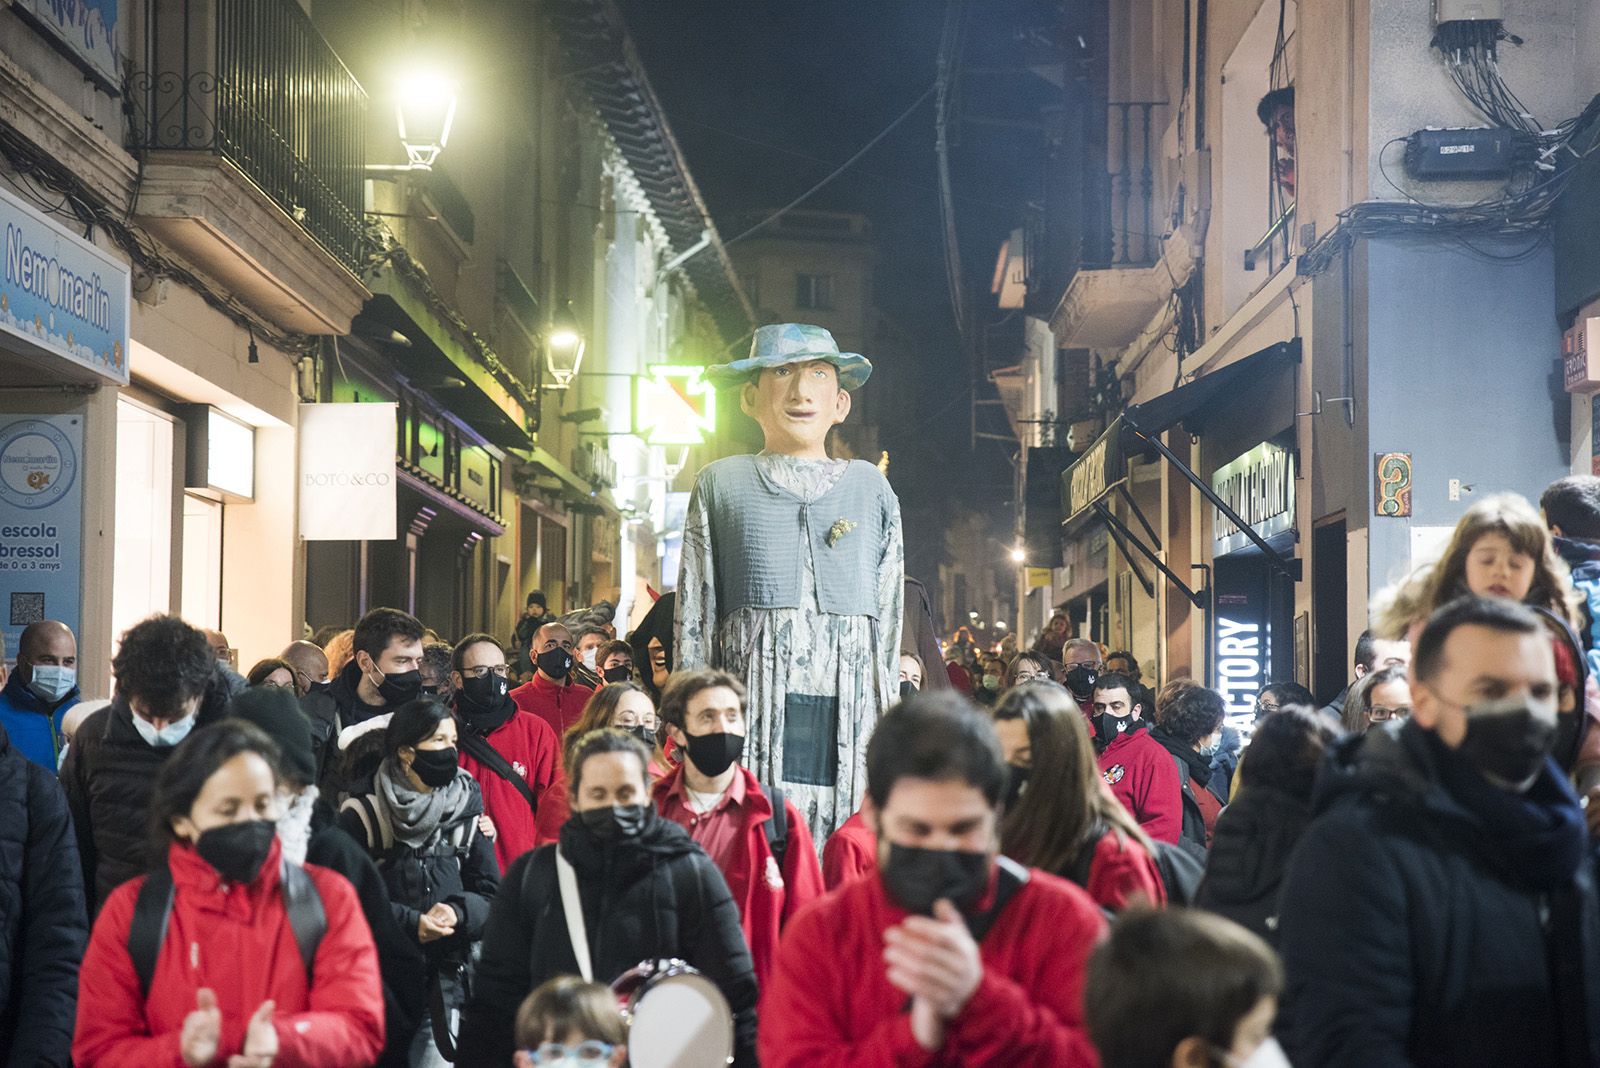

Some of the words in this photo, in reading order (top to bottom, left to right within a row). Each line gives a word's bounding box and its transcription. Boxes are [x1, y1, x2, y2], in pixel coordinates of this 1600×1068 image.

[1251, 450, 1287, 526] FACTORY
[1, 522, 57, 538] escola
[0, 543, 59, 558] bressol
[11, 561, 18, 569] 0
[30, 561, 36, 569] 3
[39, 563, 60, 571] anys
[1218, 617, 1260, 746] ACTORY
